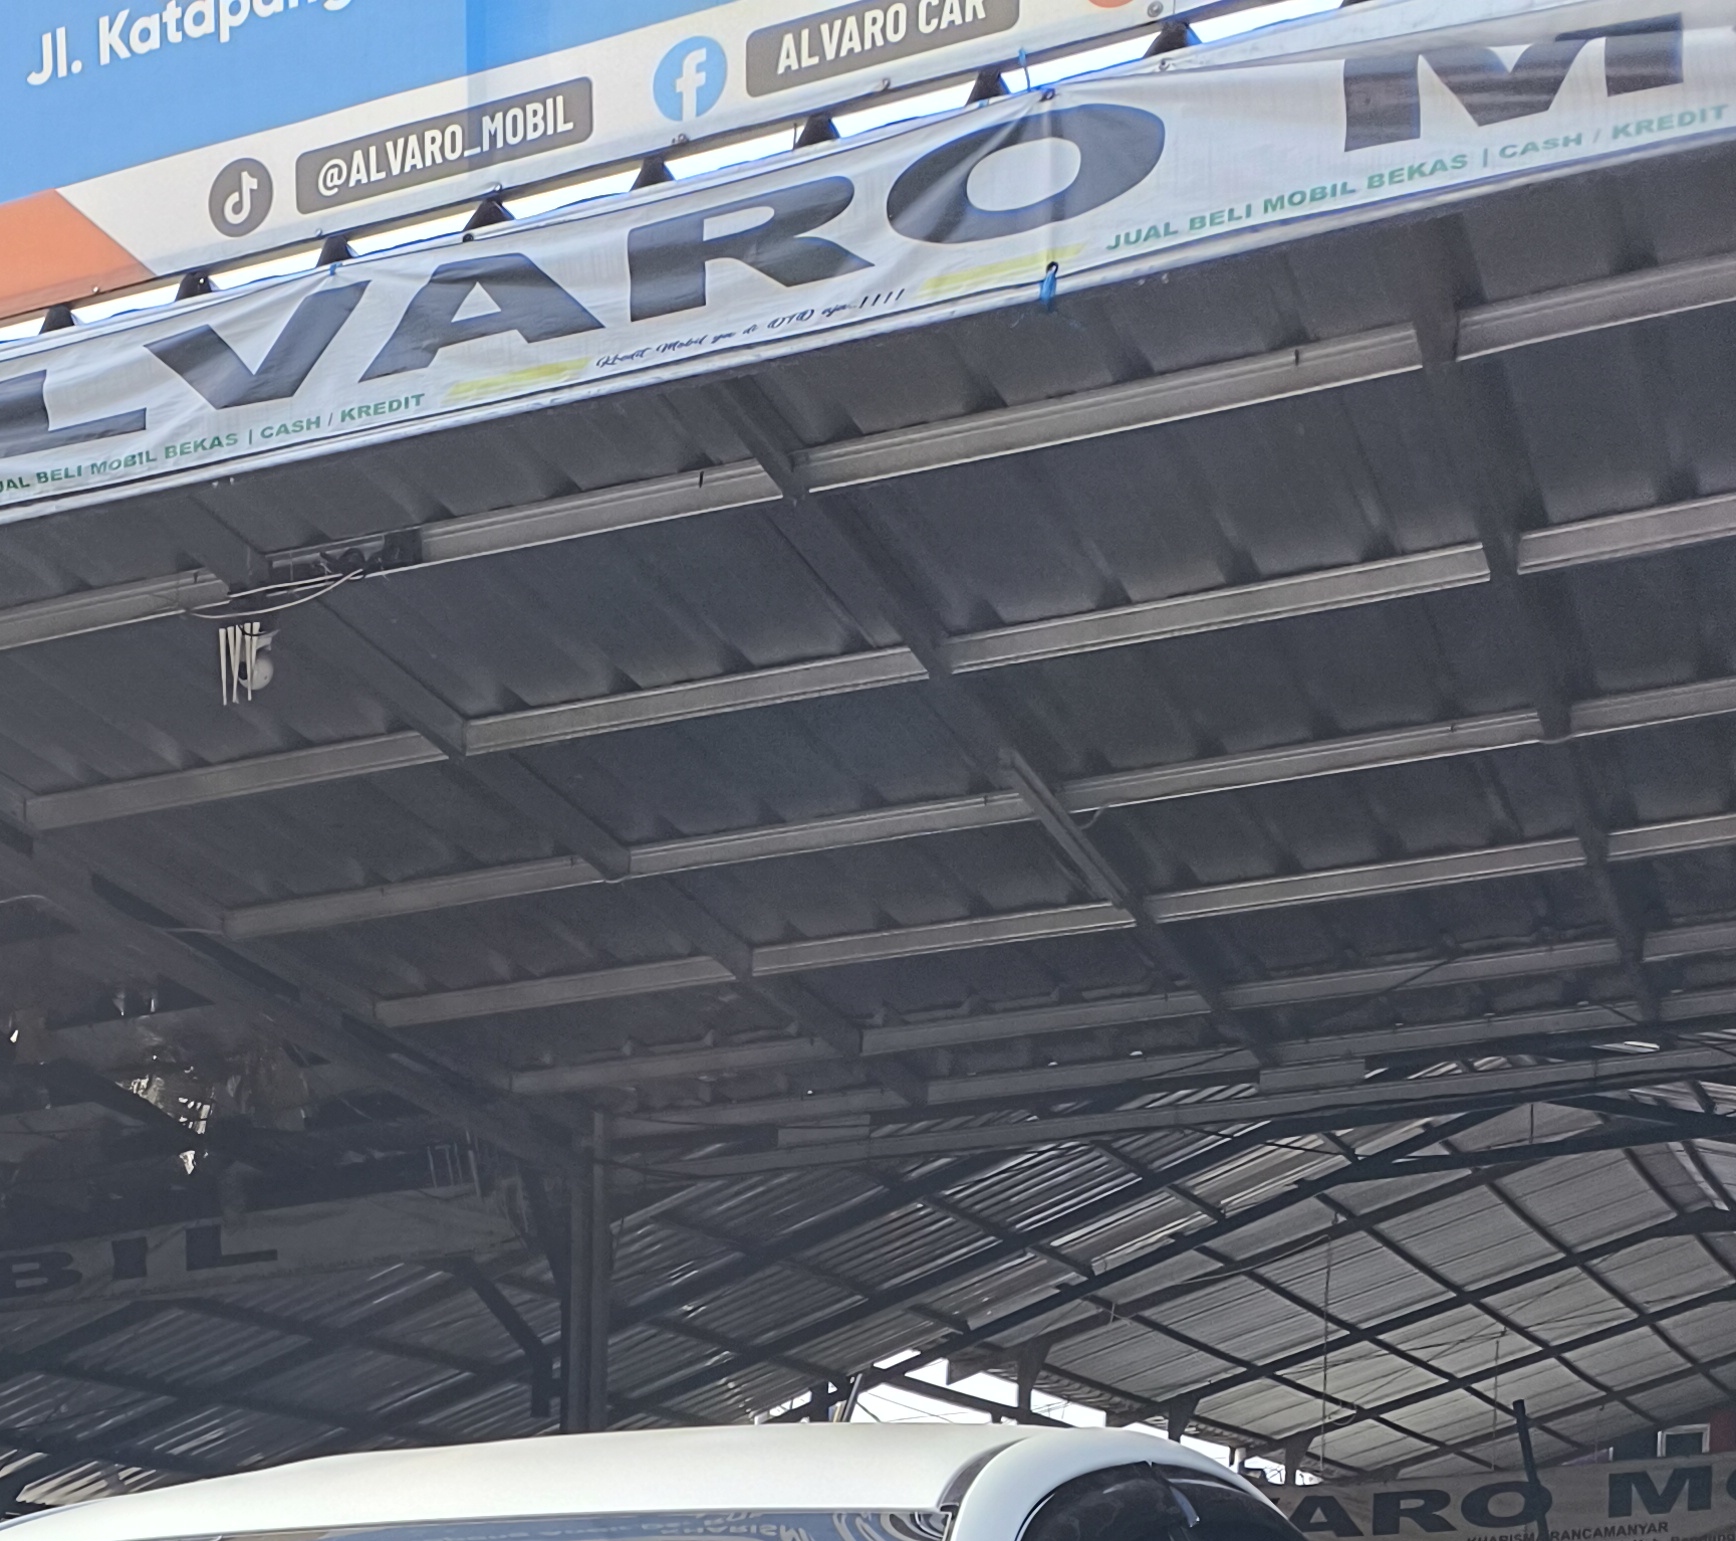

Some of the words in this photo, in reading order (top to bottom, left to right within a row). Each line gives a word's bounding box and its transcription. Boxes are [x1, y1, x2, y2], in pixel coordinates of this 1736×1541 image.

[26, 26, 83, 86] Jl.
[98, 0, 352, 66] Katapa
[776, 2, 907, 75] ALVARO
[917, 0, 986, 34] CAR
[317, 95, 574, 197] @ALVARO_MOBIL
[1105, 221, 1180, 251] JUAL
[1188, 203, 1253, 232] BELI
[1263, 181, 1357, 215] MOBIL
[1366, 153, 1469, 190] BEKAS
[1498, 132, 1584, 159] CASH
[1611, 104, 1730, 139] KREDIT
[35, 463, 83, 485] BELI
[90, 449, 157, 475] MOBIL
[164, 432, 239, 460] BEKAS
[260, 415, 321, 440] CASH
[340, 393, 426, 423] KREDIT
[1288, 1480, 1553, 1539] ARO
[1608, 1464, 1736, 1519] M
